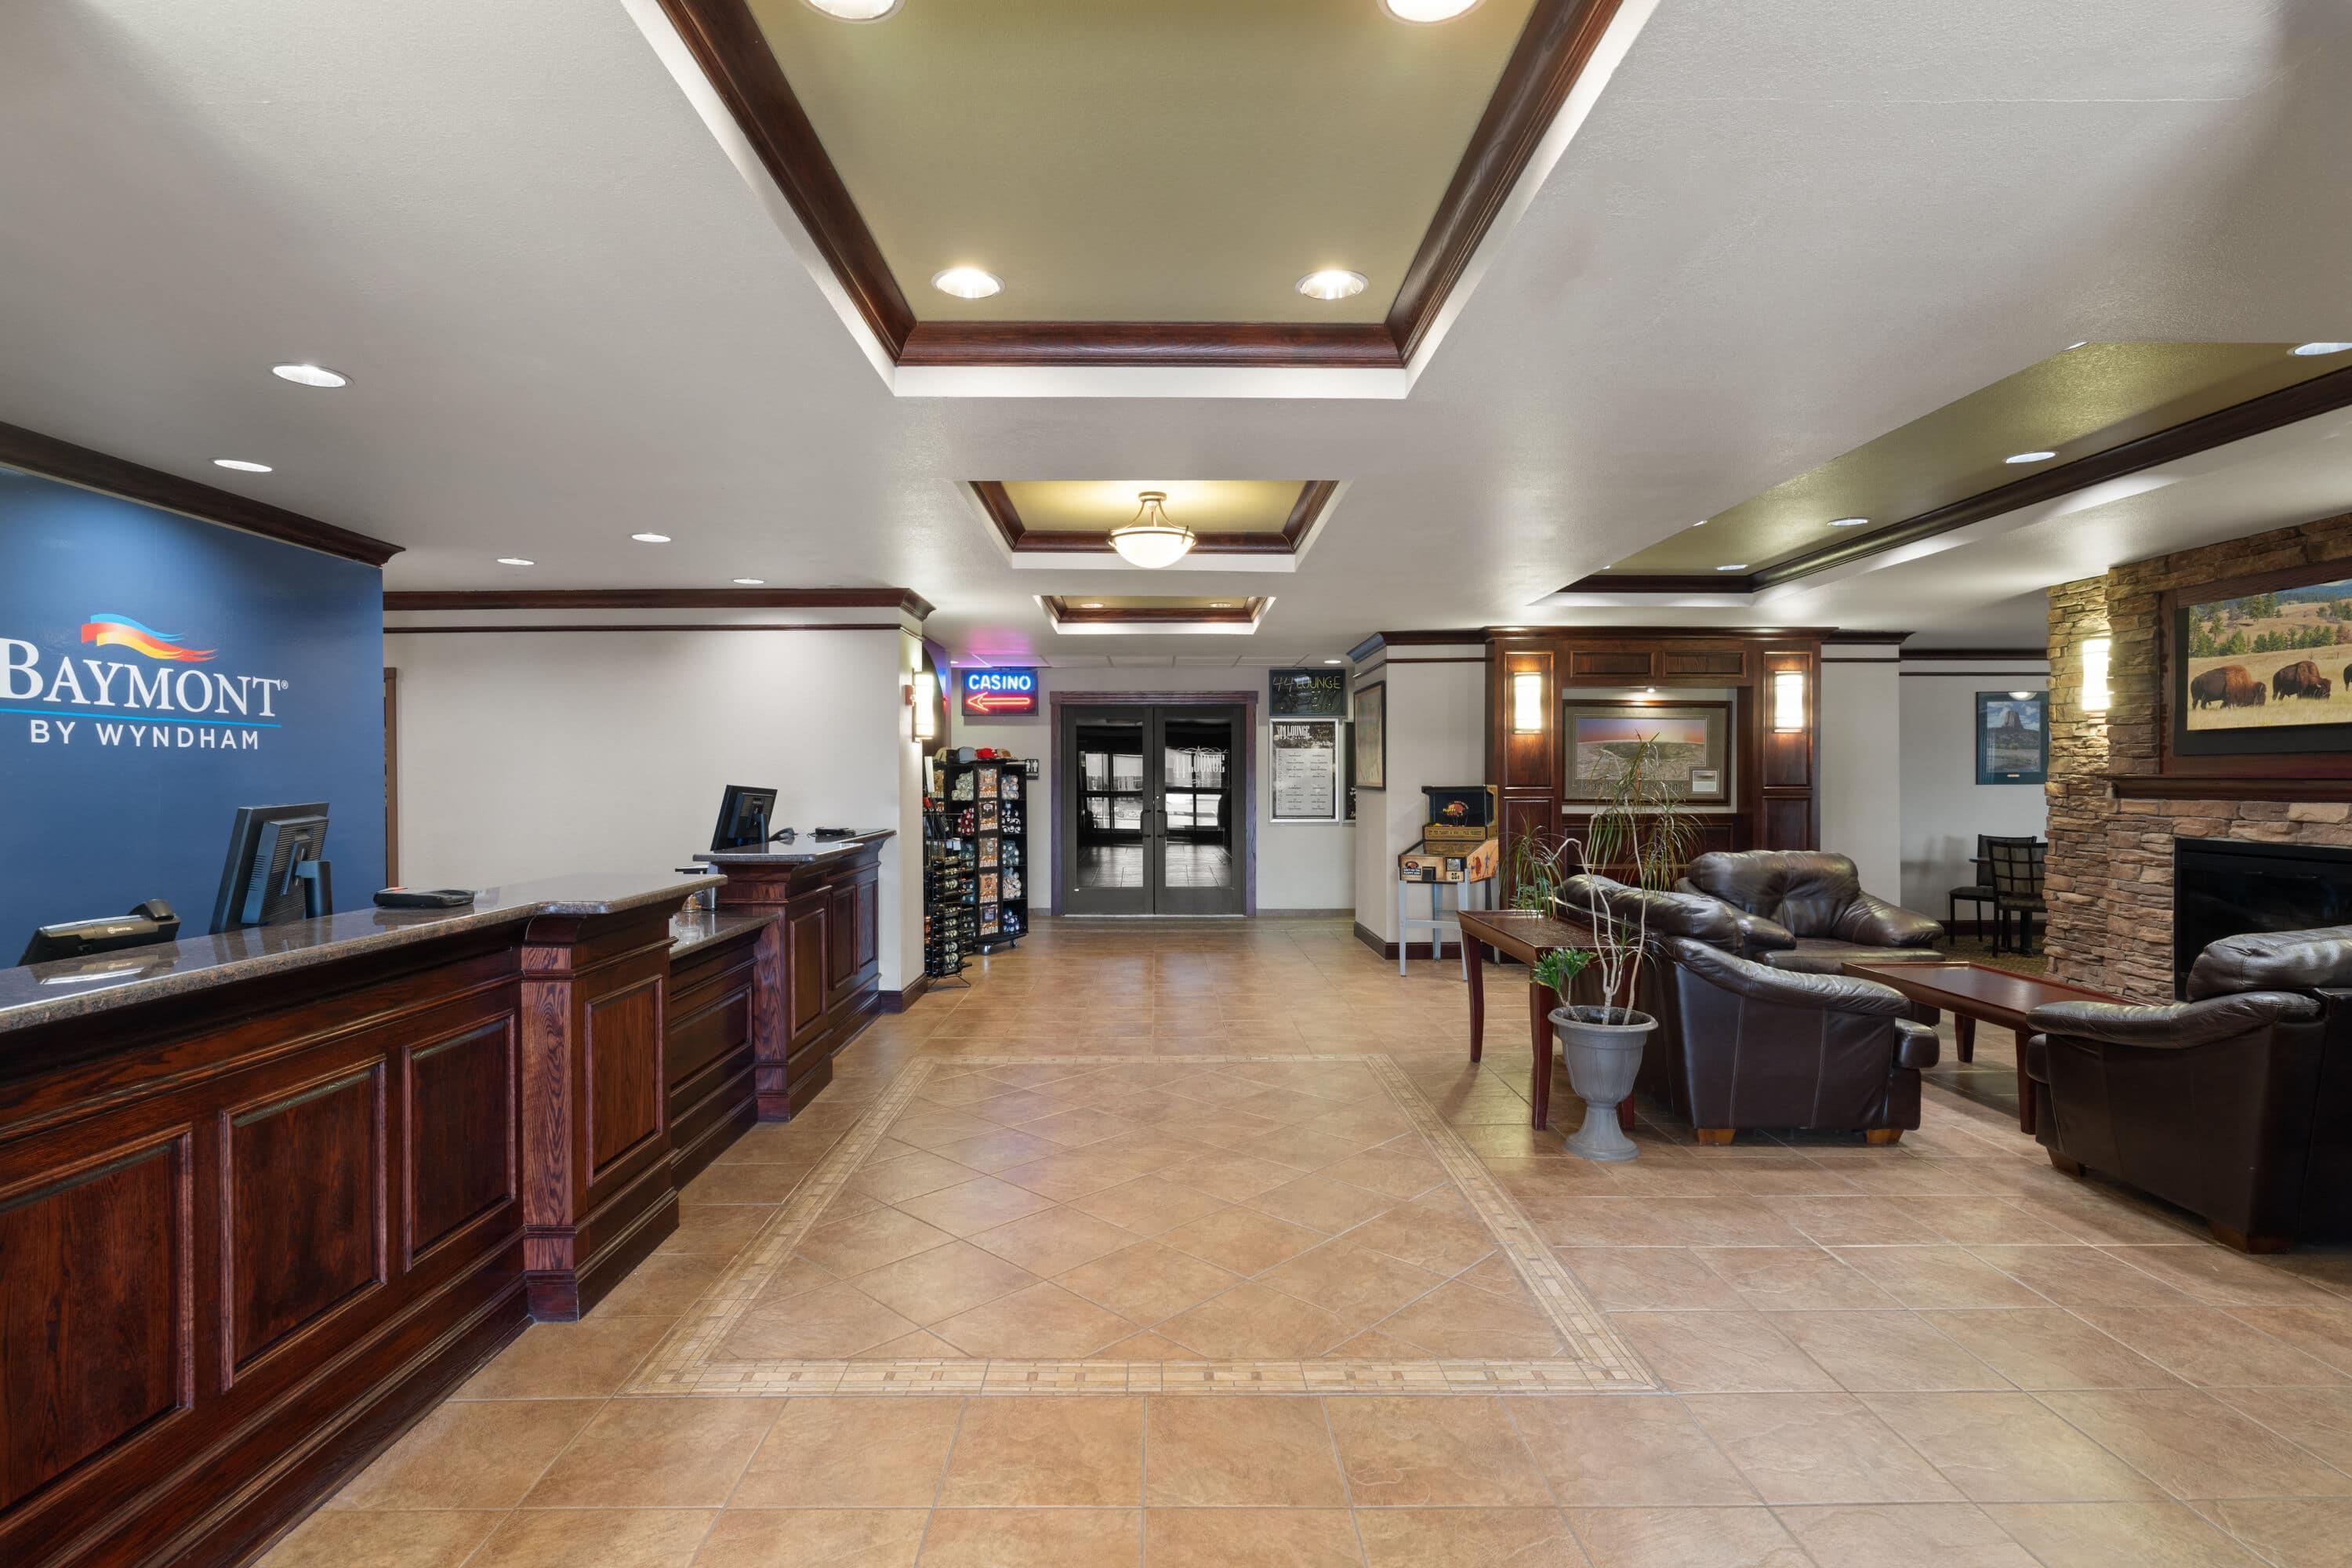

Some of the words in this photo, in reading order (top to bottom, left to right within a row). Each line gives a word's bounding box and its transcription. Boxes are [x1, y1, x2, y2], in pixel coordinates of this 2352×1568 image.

[968, 674, 1031, 690] CASINO
[1272, 677, 1294, 692] 44
[1296, 676, 1341, 689] LOUNGE
[31, 720, 76, 744] BY
[96, 723, 259, 750] WYNDHAM
[1287, 725, 1310, 738] LOUNGE
